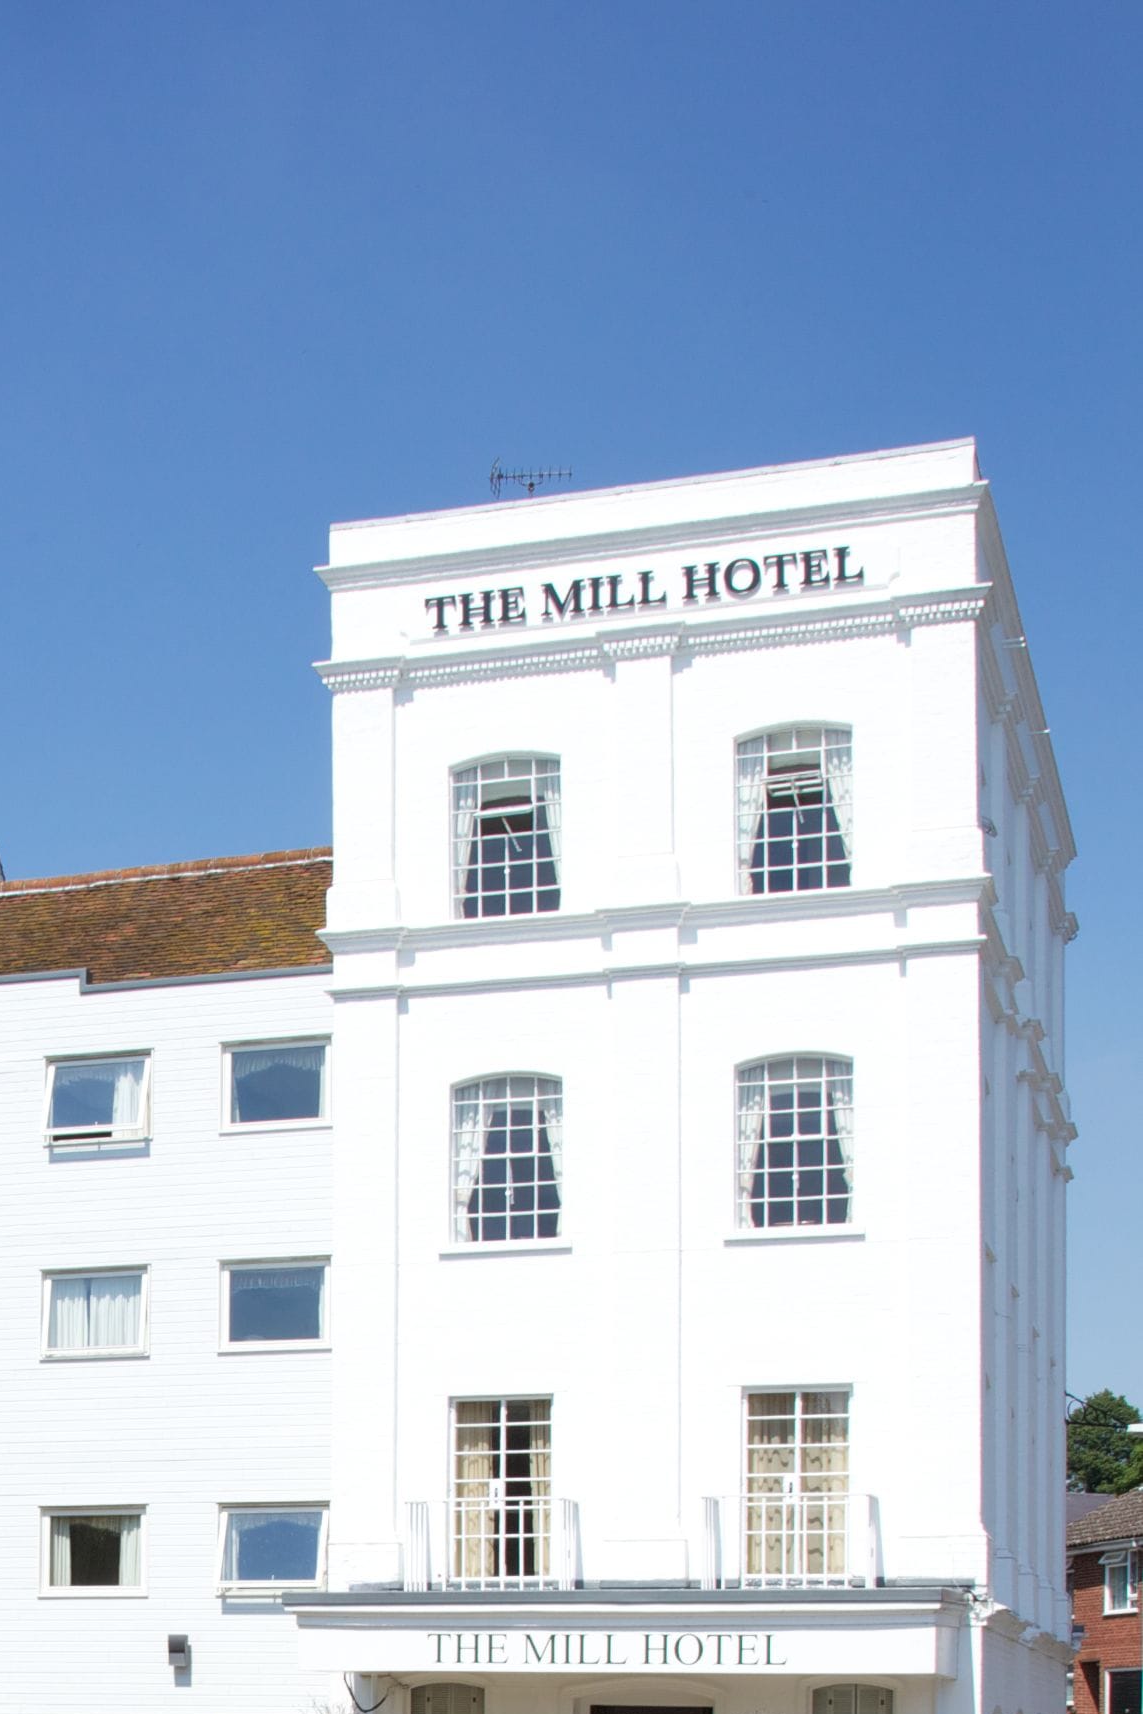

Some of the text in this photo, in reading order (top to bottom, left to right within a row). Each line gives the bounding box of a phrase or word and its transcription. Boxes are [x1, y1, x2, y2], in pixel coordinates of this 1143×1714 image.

[424, 546, 864, 630] THE MILL HOTEL
[428, 1633, 788, 1666] THE MILL HOTEL
